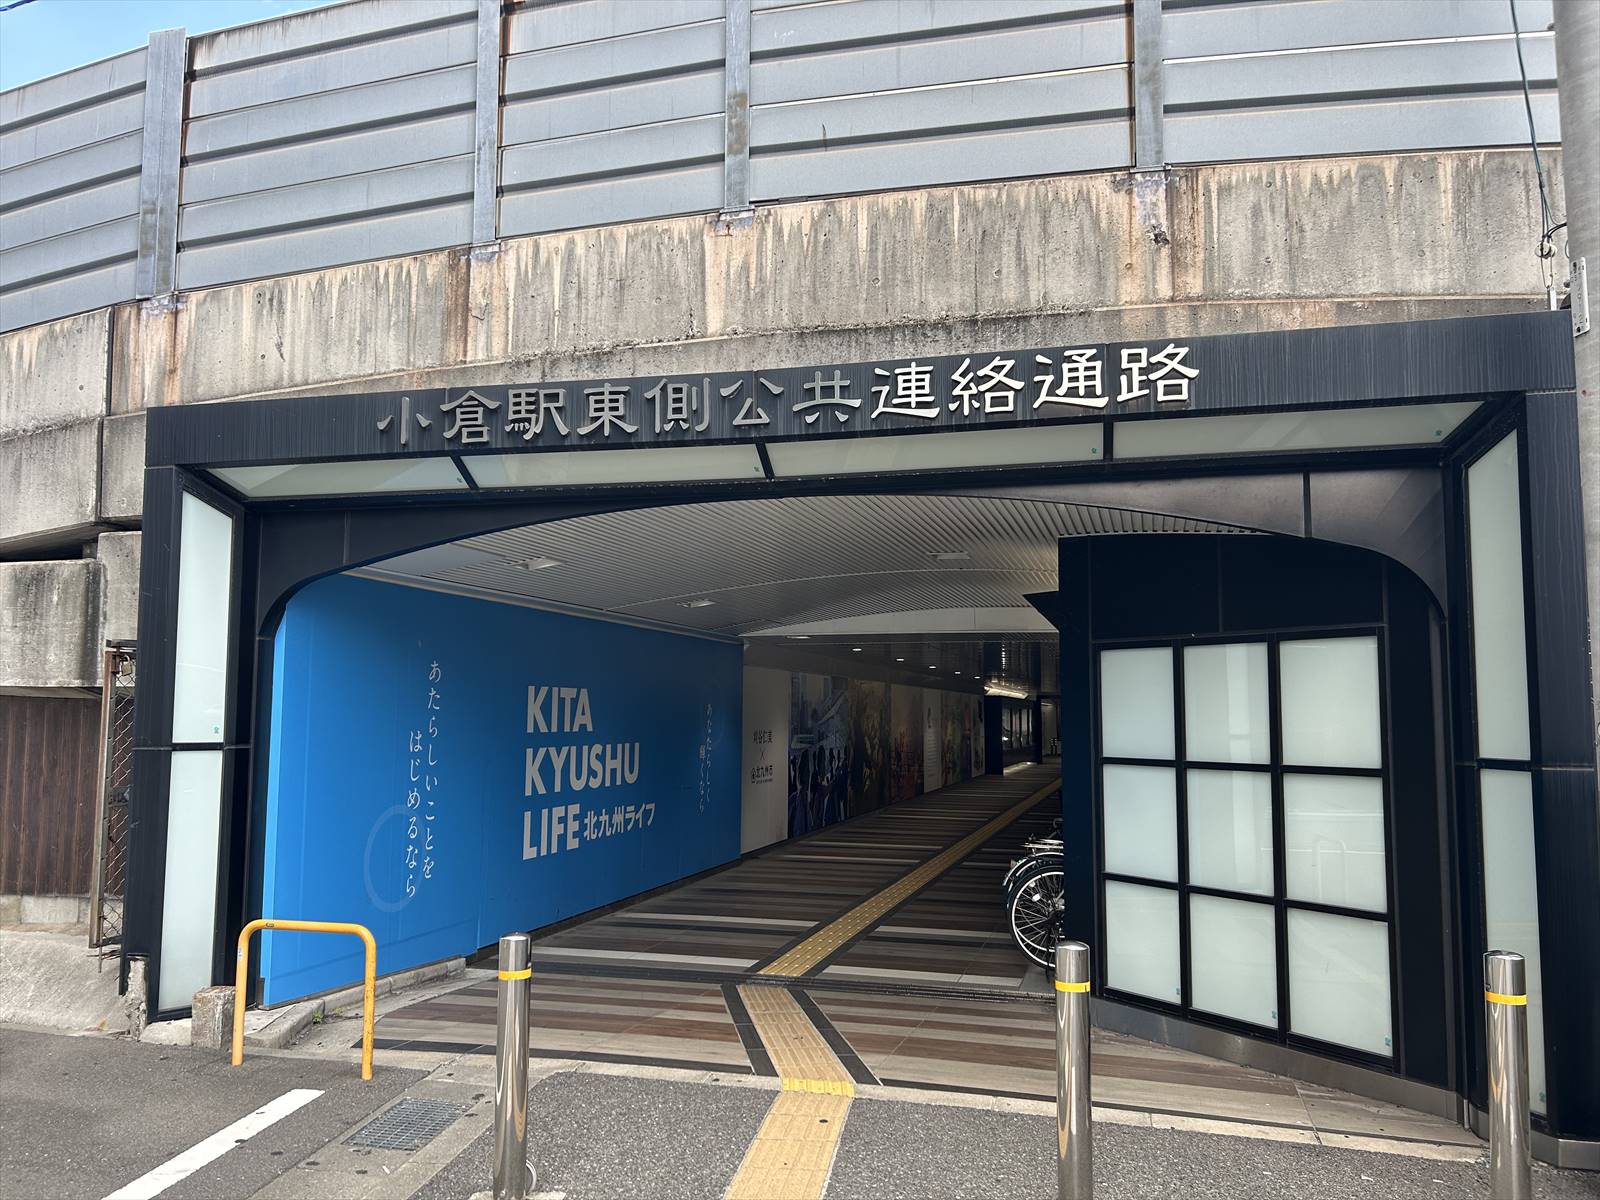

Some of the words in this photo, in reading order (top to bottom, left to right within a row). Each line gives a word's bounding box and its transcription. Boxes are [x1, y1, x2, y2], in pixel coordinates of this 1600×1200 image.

[376, 343, 1201, 446] 小倉駅東側公共連絡通路
[526, 685, 593, 734] KITA
[422, 660, 442, 879] あたらしいことを
[524, 742, 641, 797] KYUSHU
[405, 731, 423, 898] はじめるなら
[522, 803, 581, 861] LIFE
[583, 802, 656, 841] 北九州ライフ
